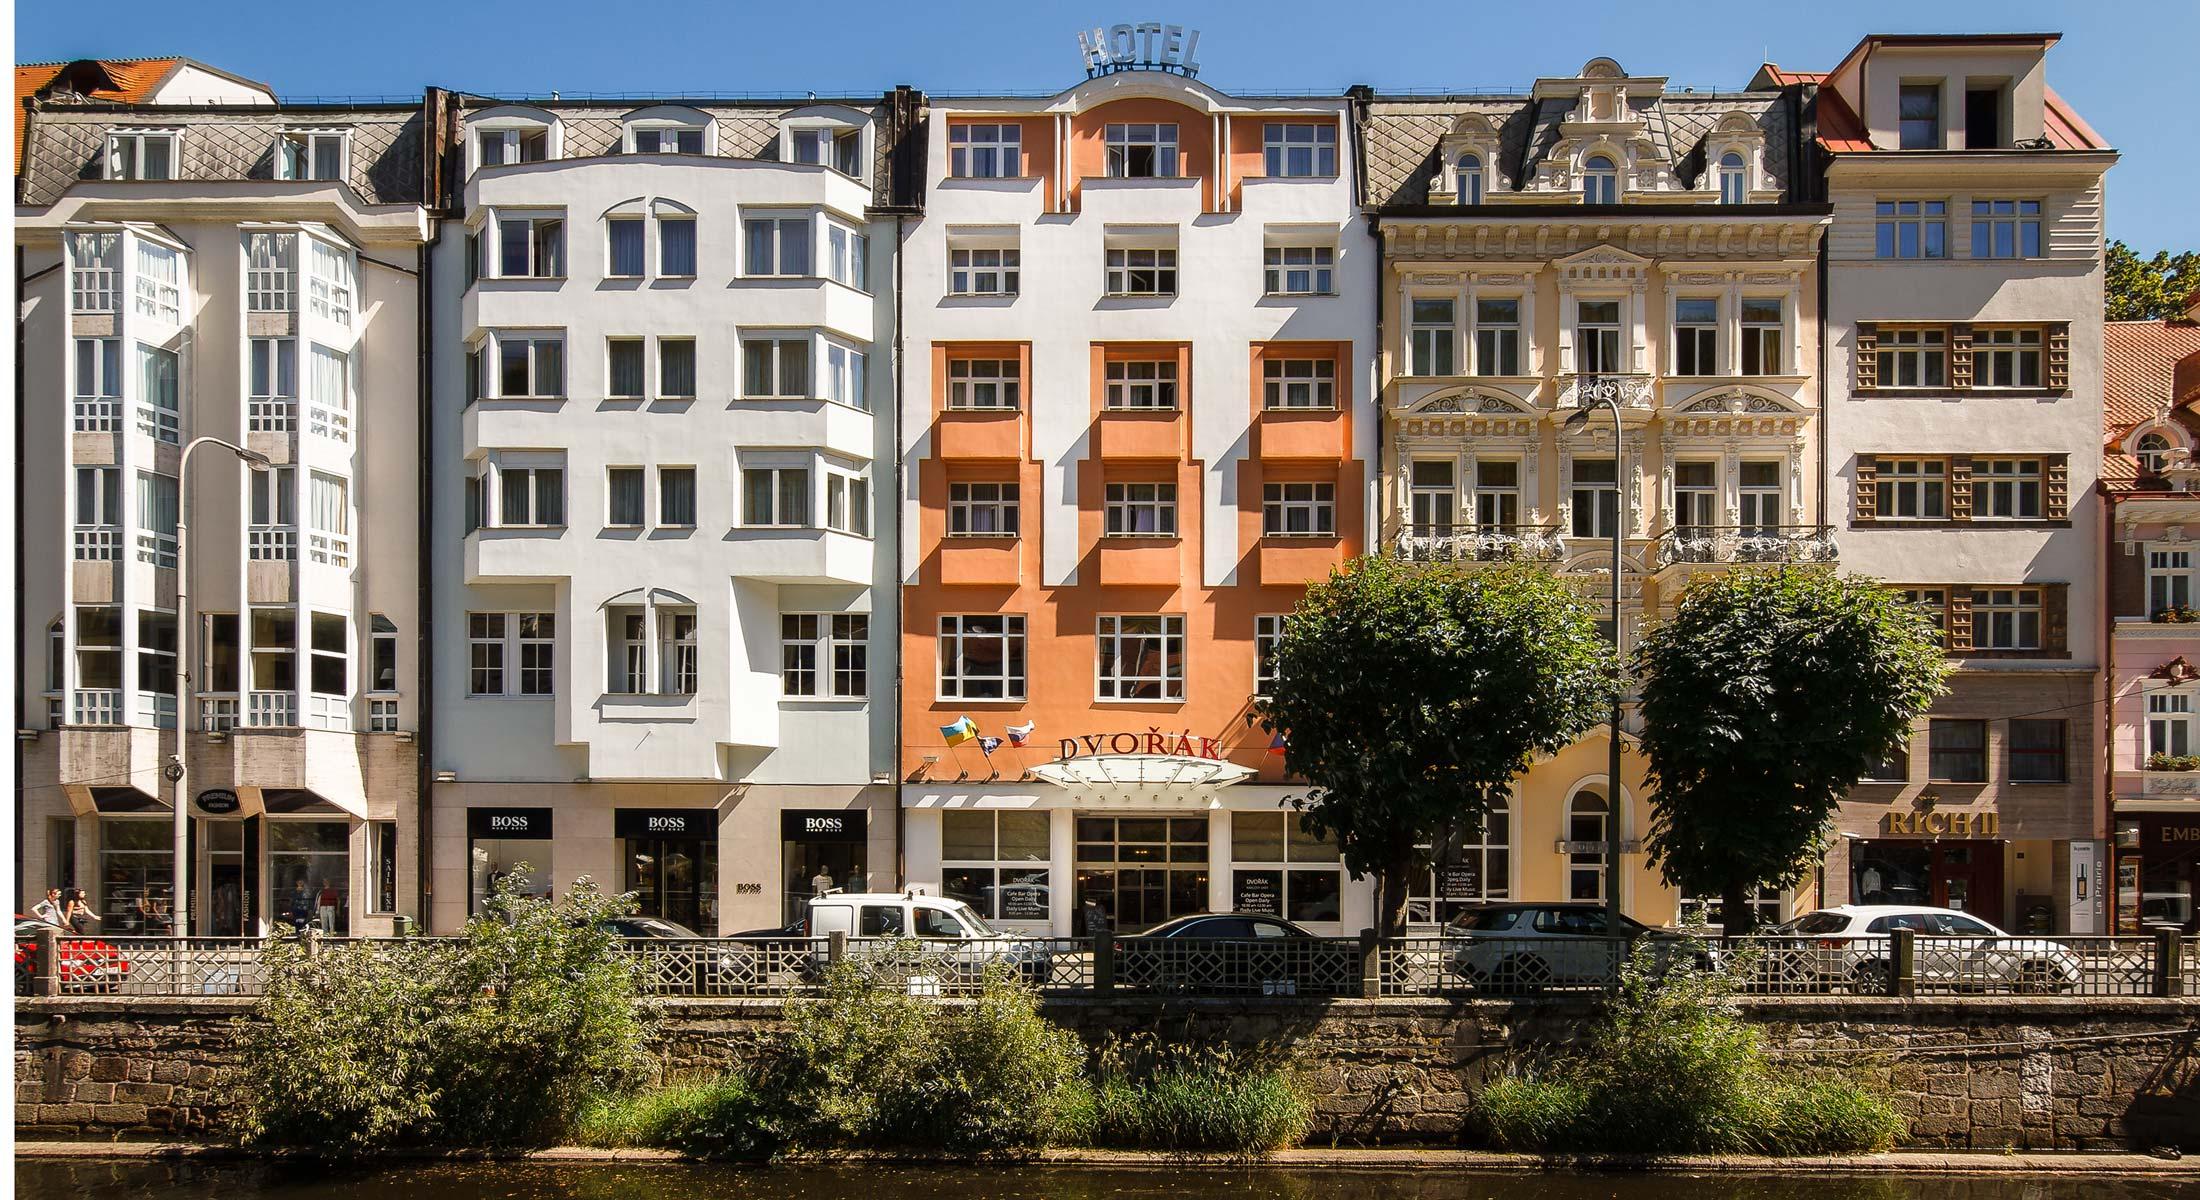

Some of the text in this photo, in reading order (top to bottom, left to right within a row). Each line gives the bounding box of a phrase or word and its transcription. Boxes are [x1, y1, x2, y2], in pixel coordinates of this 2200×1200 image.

[1078, 22, 1200, 71] HOTEL
[1059, 726, 1221, 761] DVOŘÁK
[492, 816, 528, 827] BOSS
[649, 817, 685, 828] BOSS
[806, 817, 842, 828] BOSS
[1888, 811, 1999, 834] RICH II
[2162, 827, 2200, 842] EMB
[737, 883, 762, 891] BOSS
